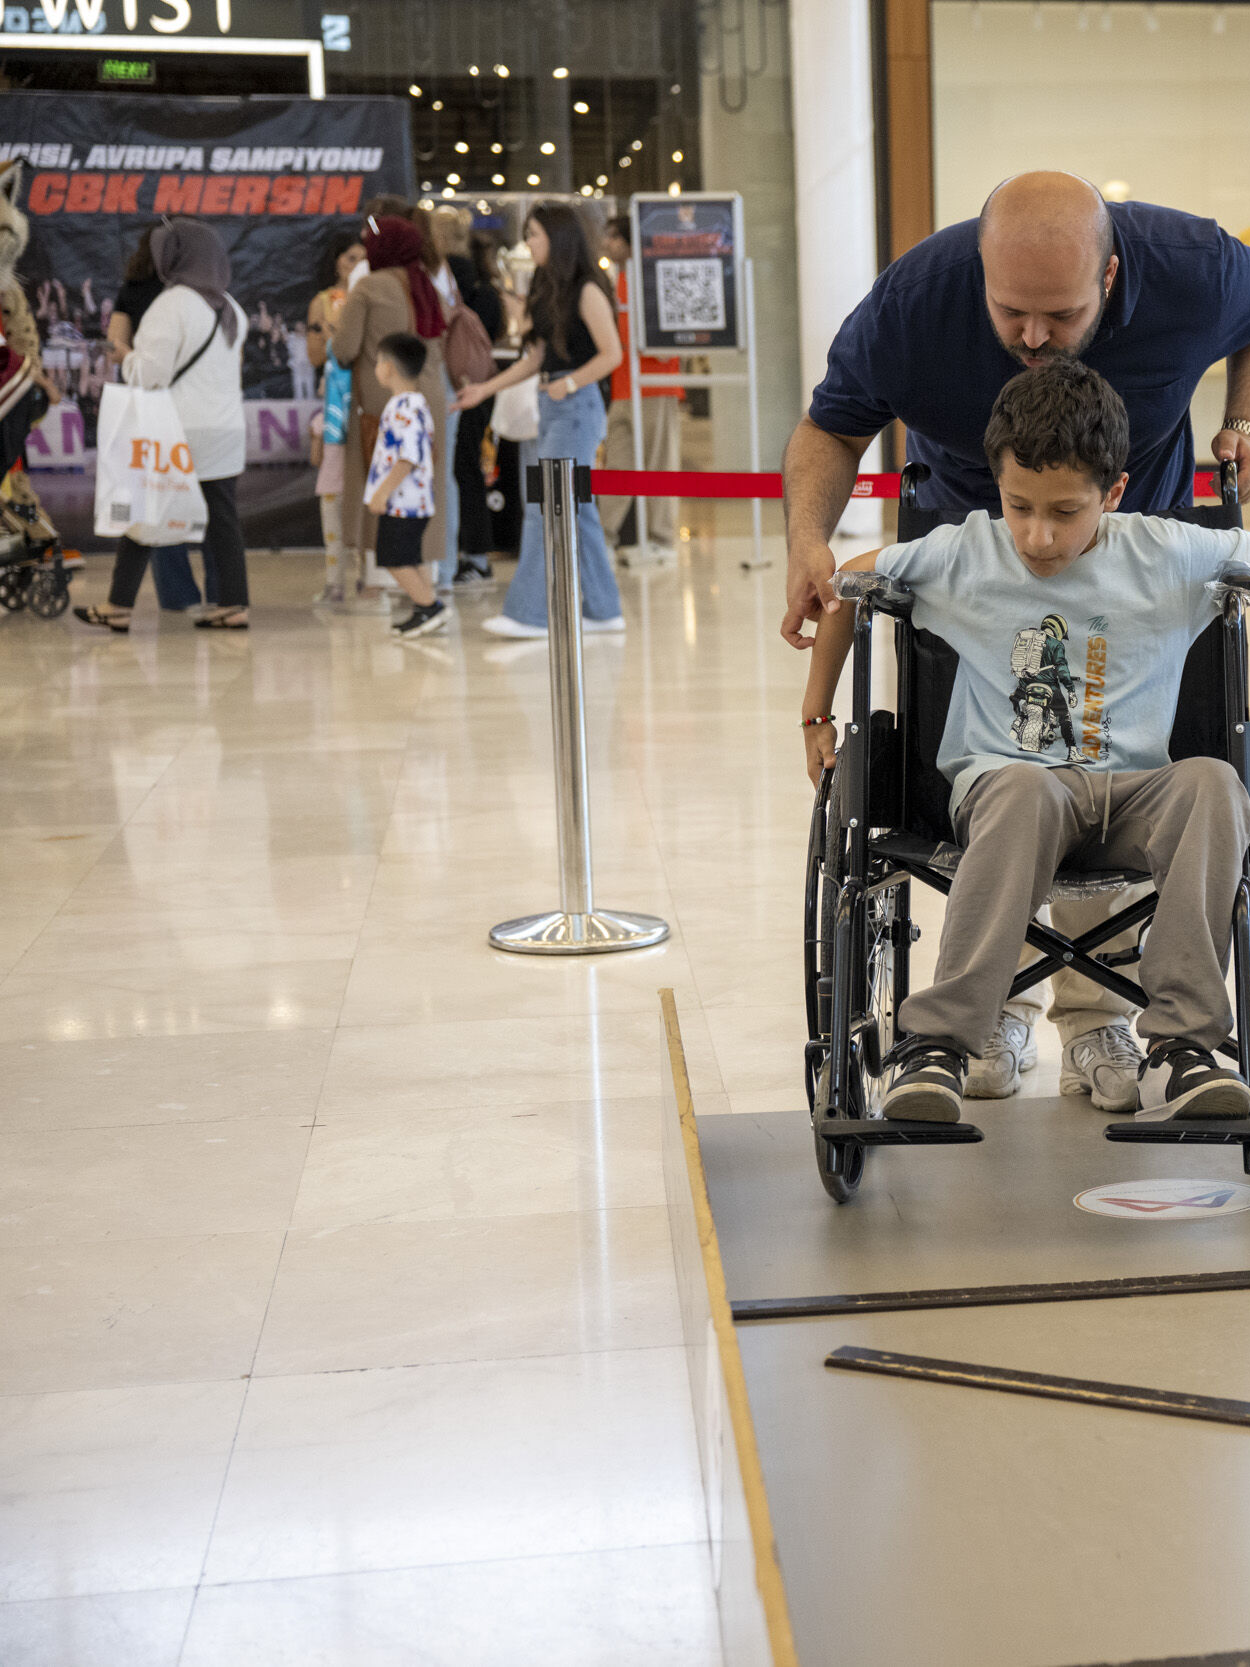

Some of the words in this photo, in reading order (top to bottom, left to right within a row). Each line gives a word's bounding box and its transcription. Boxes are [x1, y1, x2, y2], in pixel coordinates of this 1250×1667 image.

[84, 144, 204, 170] AVRUPA
[28, 172, 145, 215] CBK
[129, 438, 194, 474] FLO
[1087, 615, 1109, 632] The
[1081, 636, 1107, 761] ADVENTURES
[1079, 1045, 1096, 1068] N
